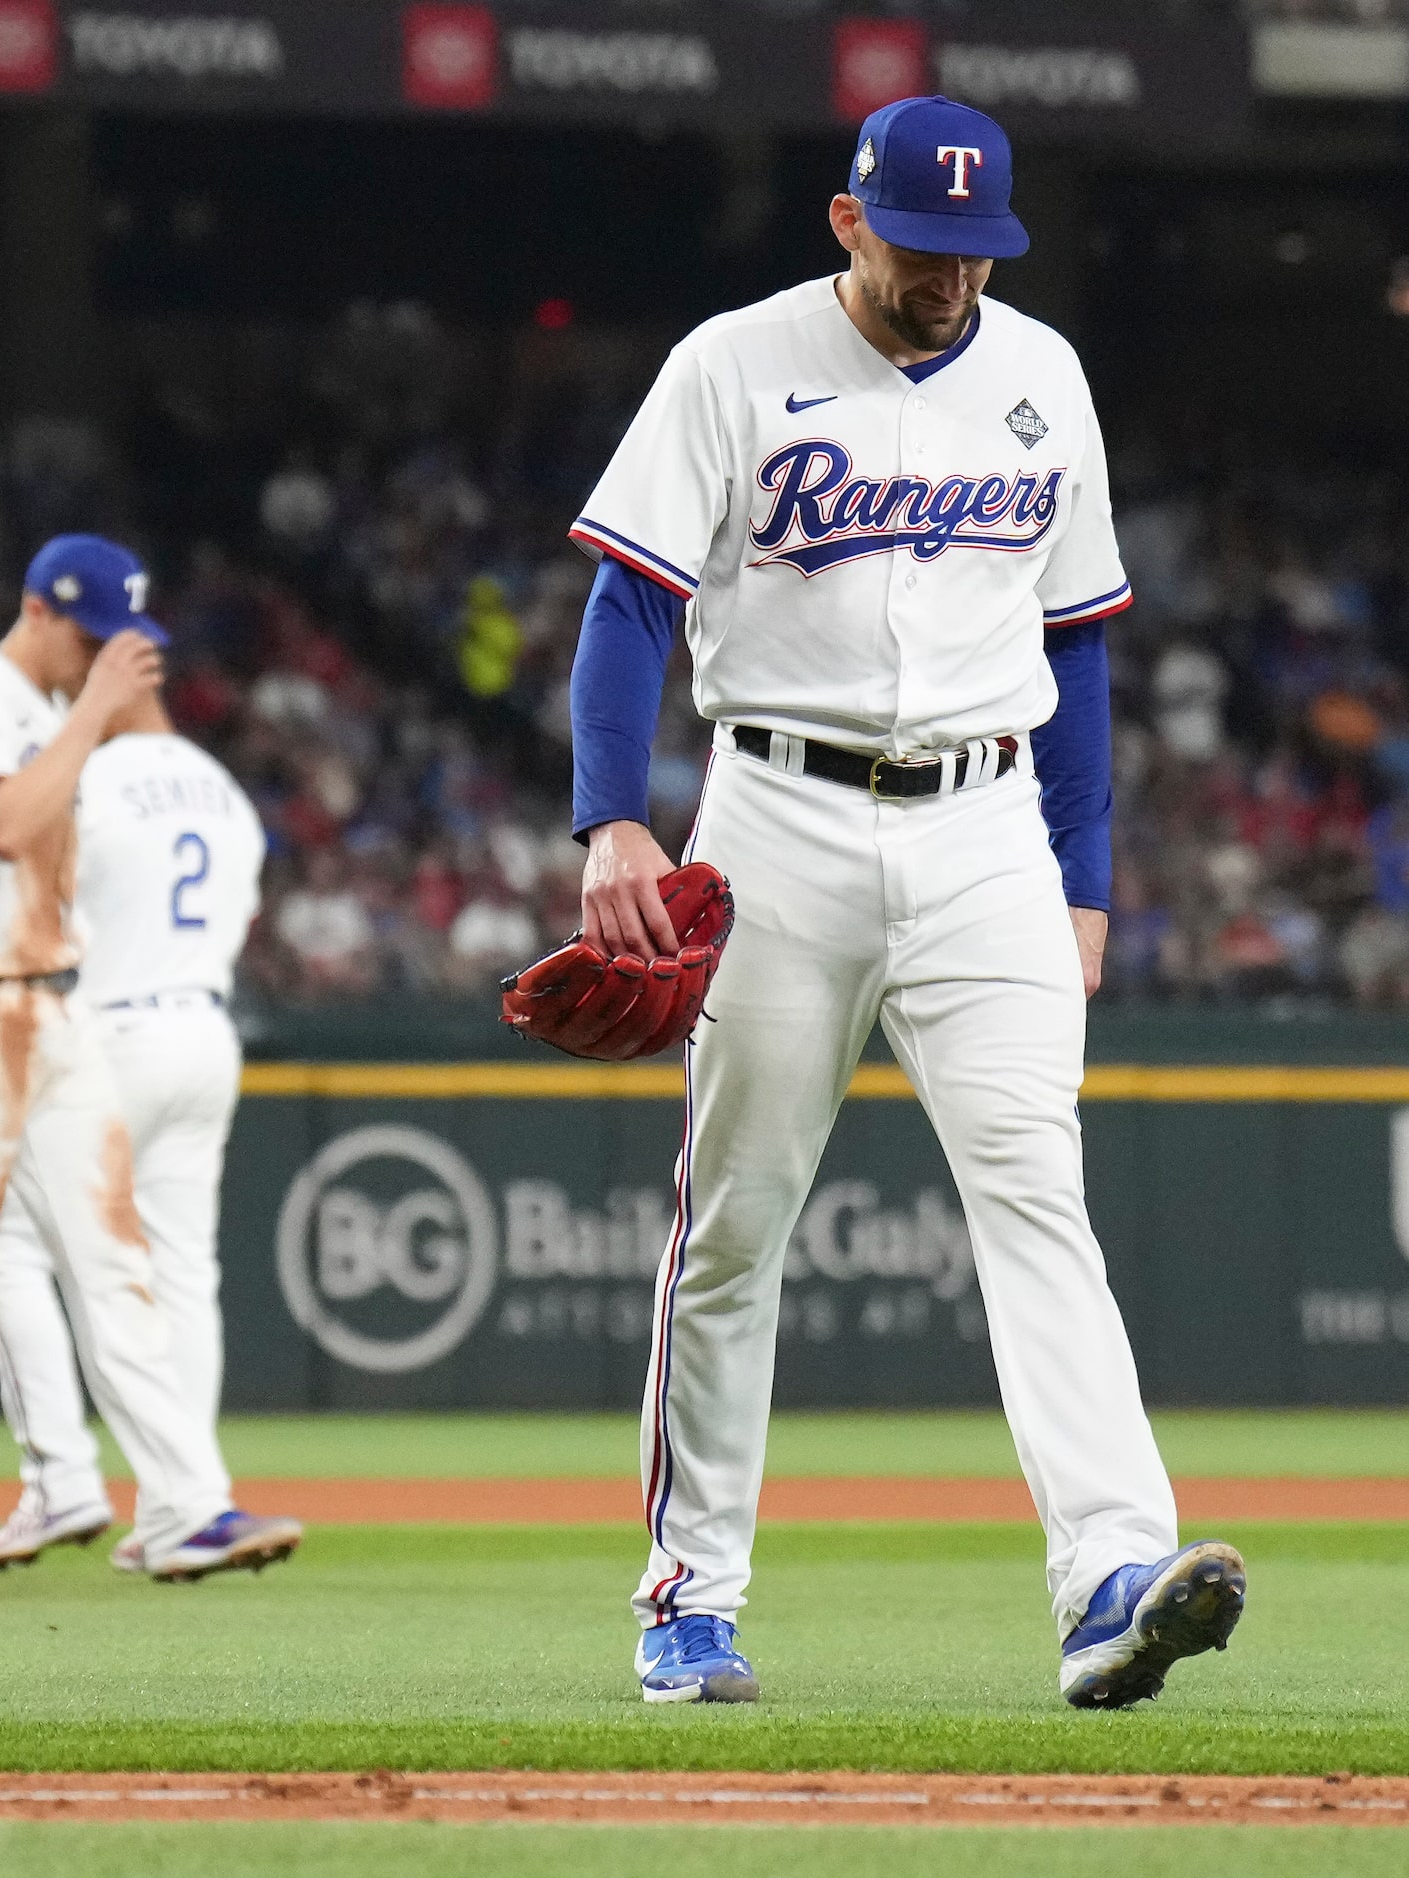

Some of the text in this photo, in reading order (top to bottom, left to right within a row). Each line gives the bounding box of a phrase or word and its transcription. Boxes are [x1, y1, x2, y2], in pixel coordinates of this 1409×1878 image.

[70, 11, 284, 76] TOYOTA
[509, 29, 716, 93] TOYOTA
[938, 45, 1140, 105] TOYOTA
[937, 146, 983, 199] T
[748, 437, 1067, 579] Rangers
[171, 830, 211, 930] 2
[317, 1186, 471, 1300] BG
[503, 1177, 669, 1281] Bail
